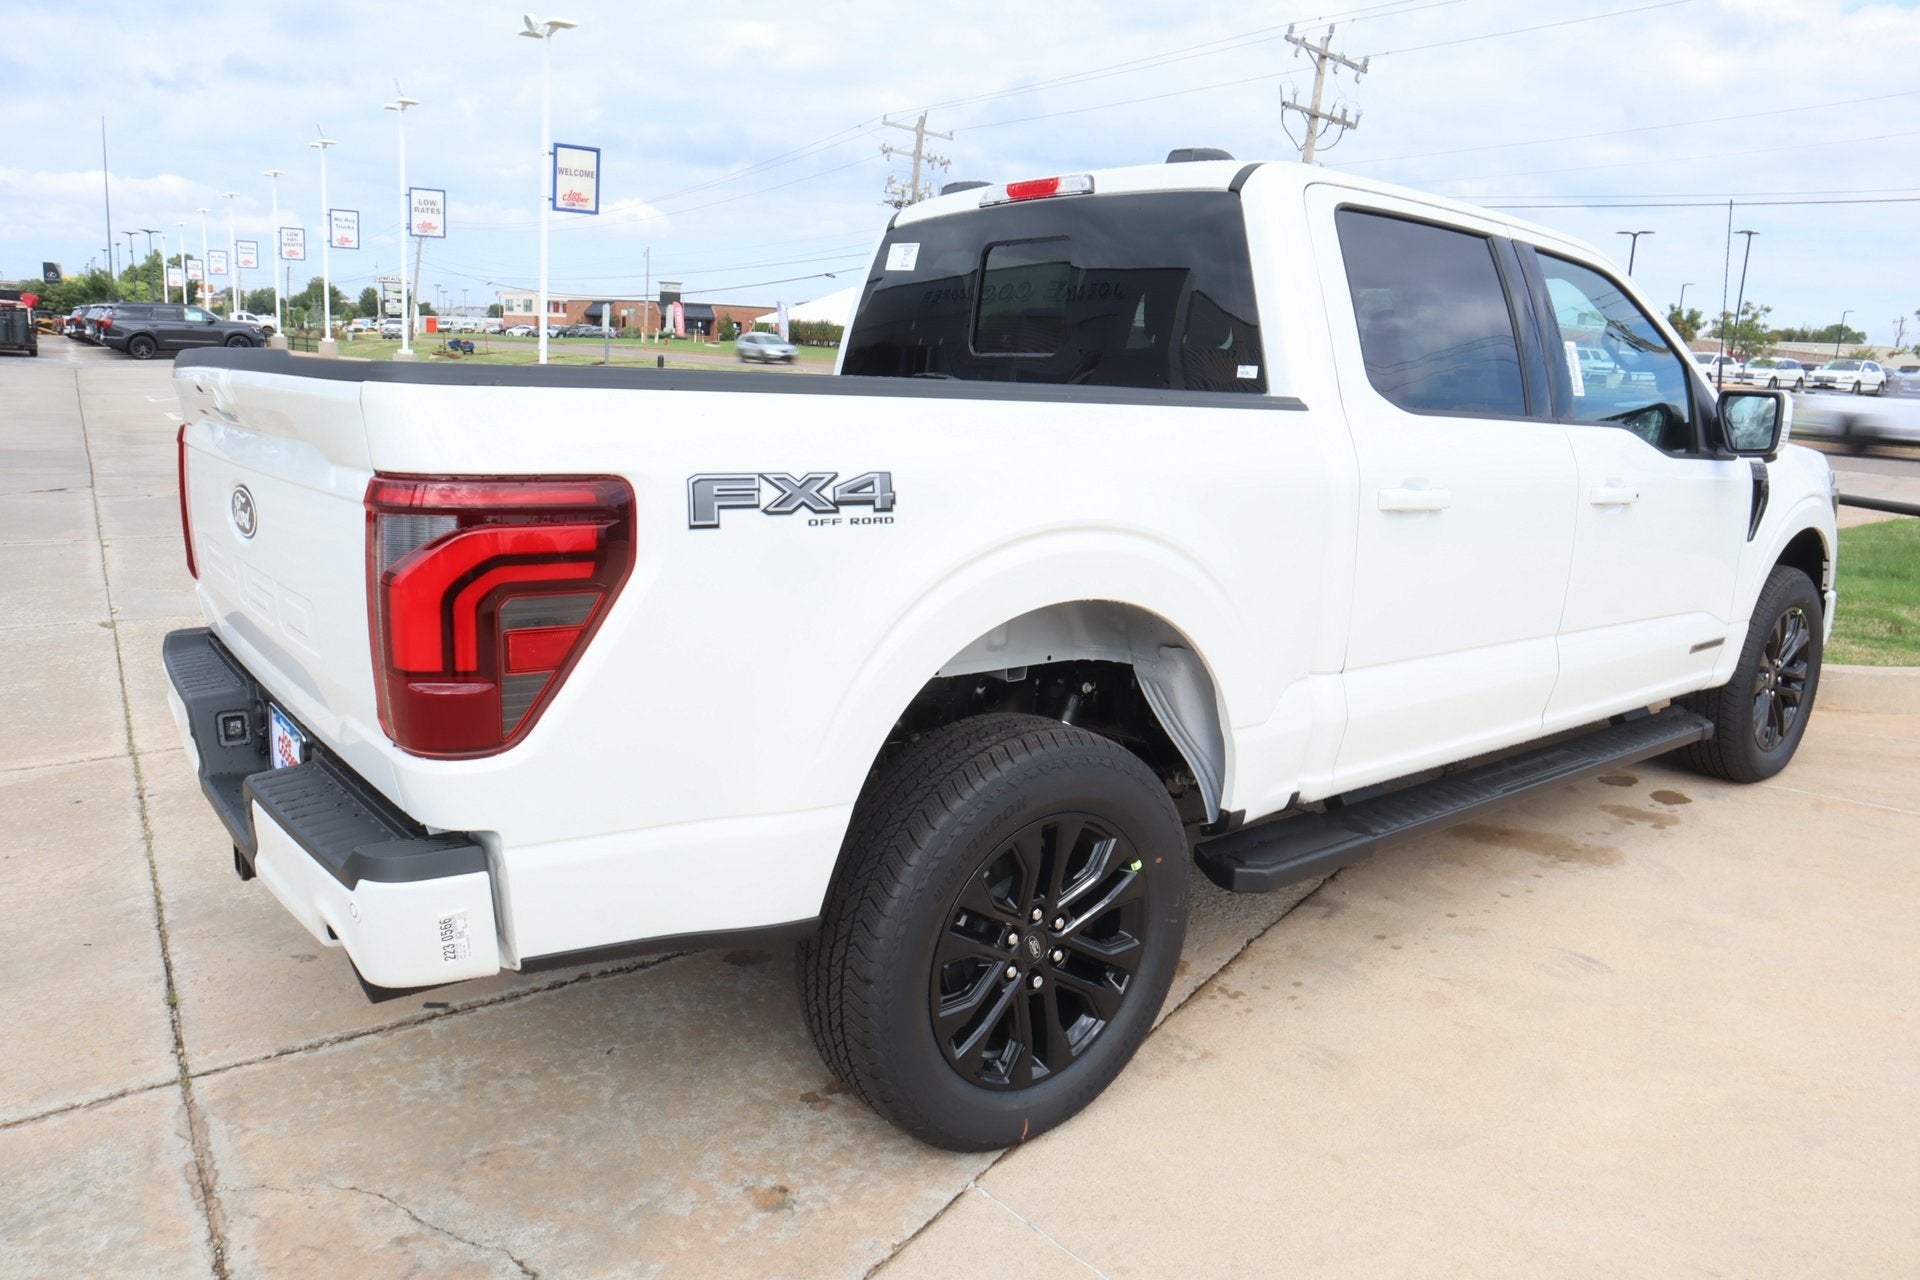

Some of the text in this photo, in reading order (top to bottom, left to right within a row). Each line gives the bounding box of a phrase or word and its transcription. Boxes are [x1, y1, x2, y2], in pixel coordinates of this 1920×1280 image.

[558, 167, 595, 179] WELCOME
[562, 194, 590, 203] Cooper
[569, 189, 583, 198] Joe
[414, 206, 441, 215] RATES
[687, 471, 896, 530] FX4
[233, 490, 252, 531] Ford
[808, 516, 895, 527] OFF ROAD
[439, 916, 457, 962] 223 0566
